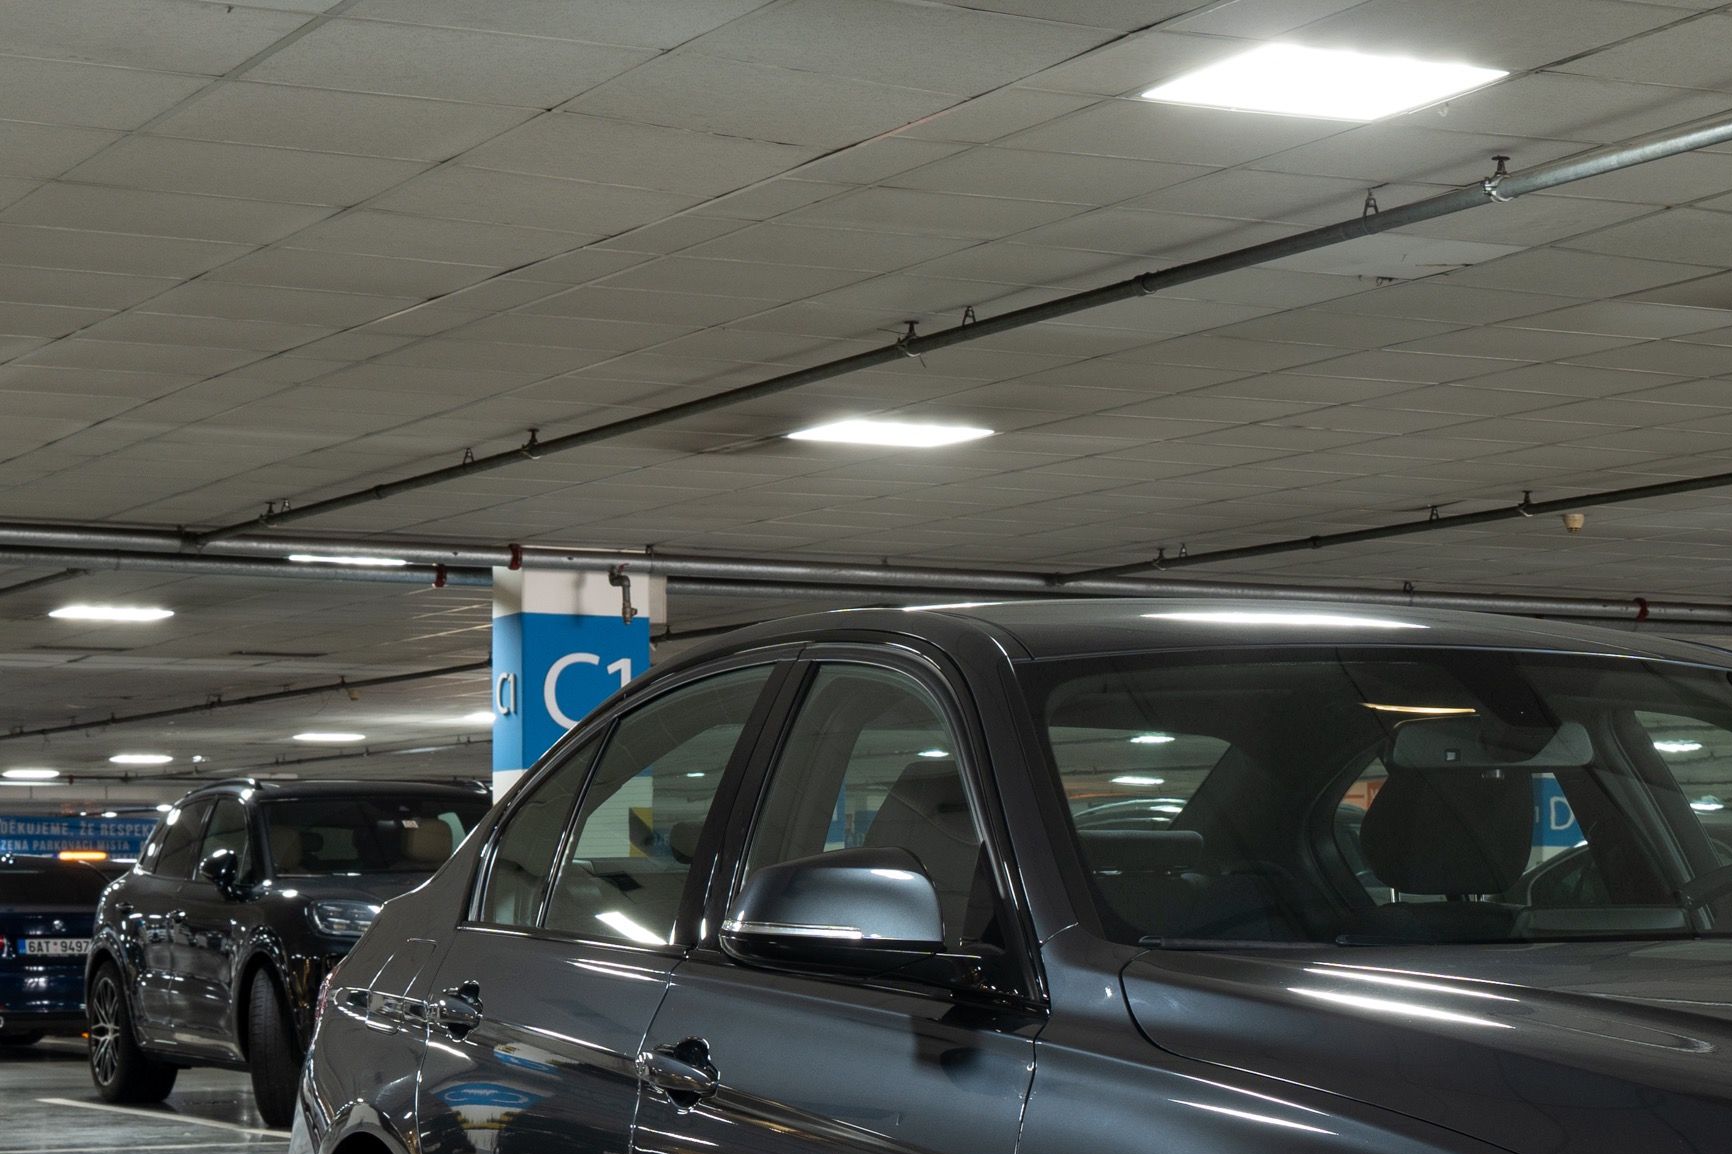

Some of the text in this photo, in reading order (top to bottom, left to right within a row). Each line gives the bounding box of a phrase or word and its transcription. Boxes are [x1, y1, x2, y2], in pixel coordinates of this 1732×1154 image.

[496, 672, 517, 715] C1
[100, 823, 153, 837] RESPEK
[28, 941, 90, 953] 6AT 9497
